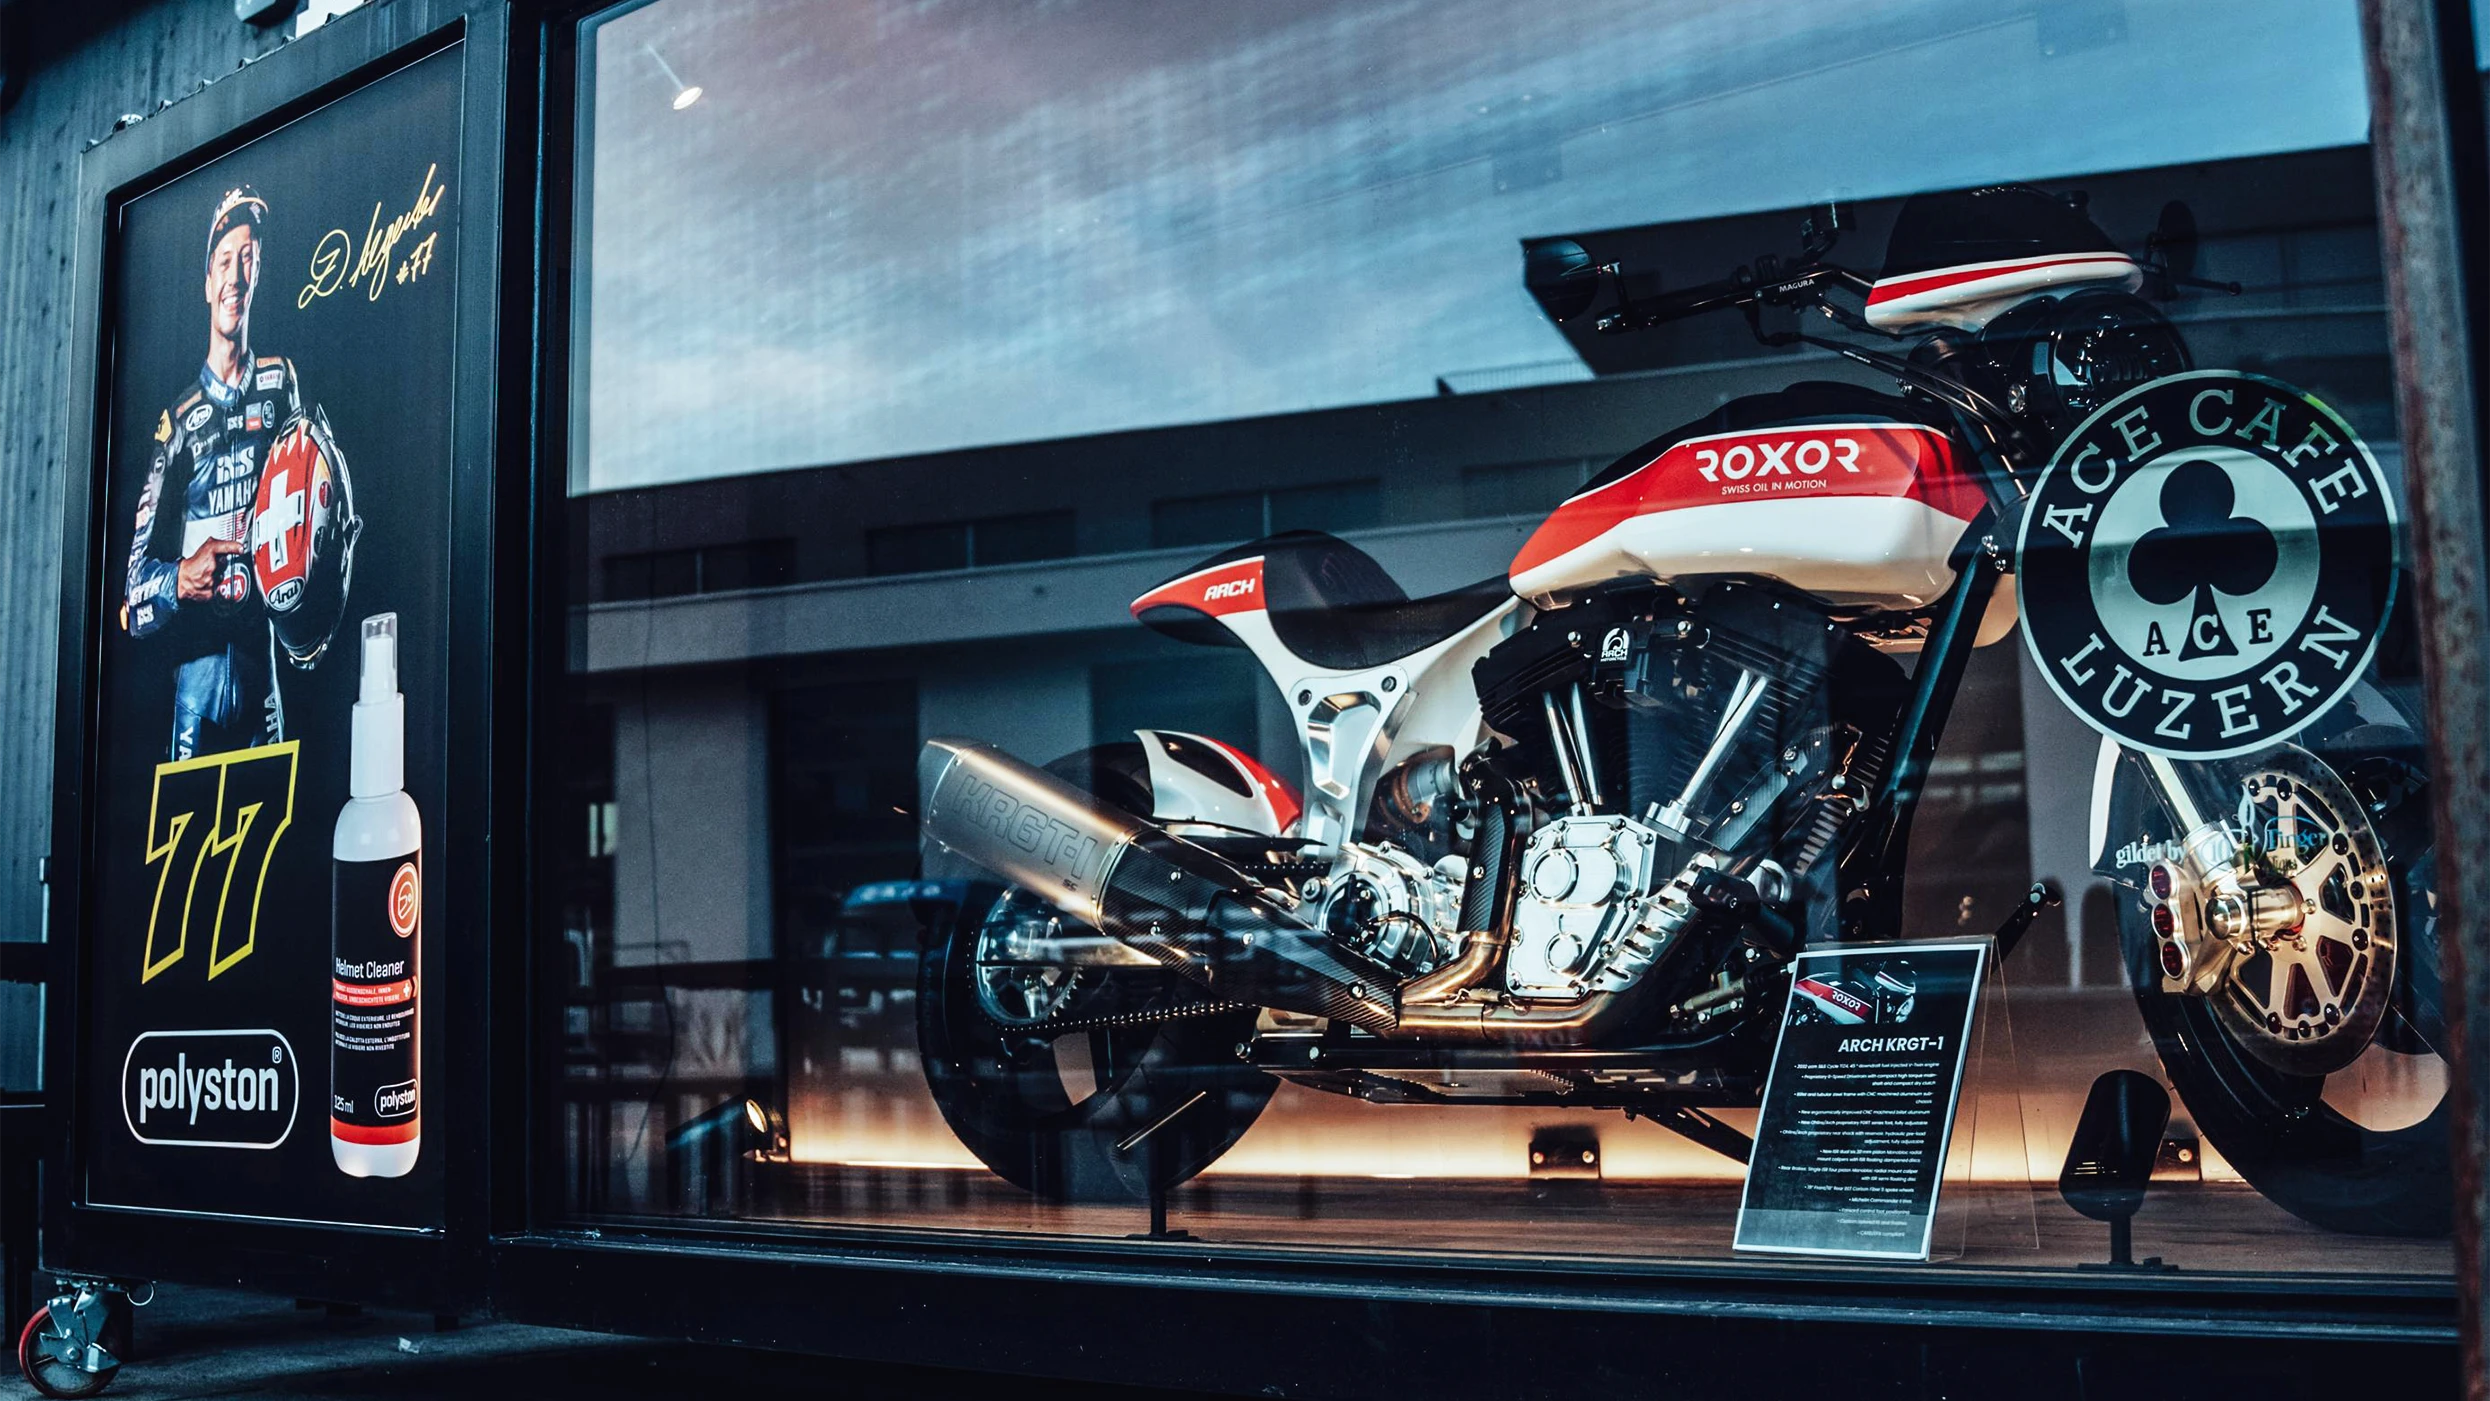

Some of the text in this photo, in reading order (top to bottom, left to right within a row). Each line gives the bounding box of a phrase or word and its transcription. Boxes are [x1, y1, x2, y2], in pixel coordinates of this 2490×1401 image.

[1780, 278, 1815, 292] MAGURA
[1696, 438, 1860, 482] ROXOR
[2042, 389, 2368, 549] ACE CAFE
[1722, 480, 1827, 495] SWISS OIL IN MOTION
[270, 578, 299, 604] Arai
[1204, 578, 1256, 602] ARCH
[2142, 608, 2274, 657] ACE
[1601, 649, 1628, 658] ARCH
[2060, 605, 2362, 740] LUZERN
[142, 740, 300, 984] 77
[336, 957, 404, 978] Helmet Cleaner
[1832, 990, 1861, 1011] ROXOR
[1838, 1036, 1944, 1052] ARCH KRGT-1
[345, 1100, 354, 1114] ml
[380, 1088, 416, 1112] polyston
